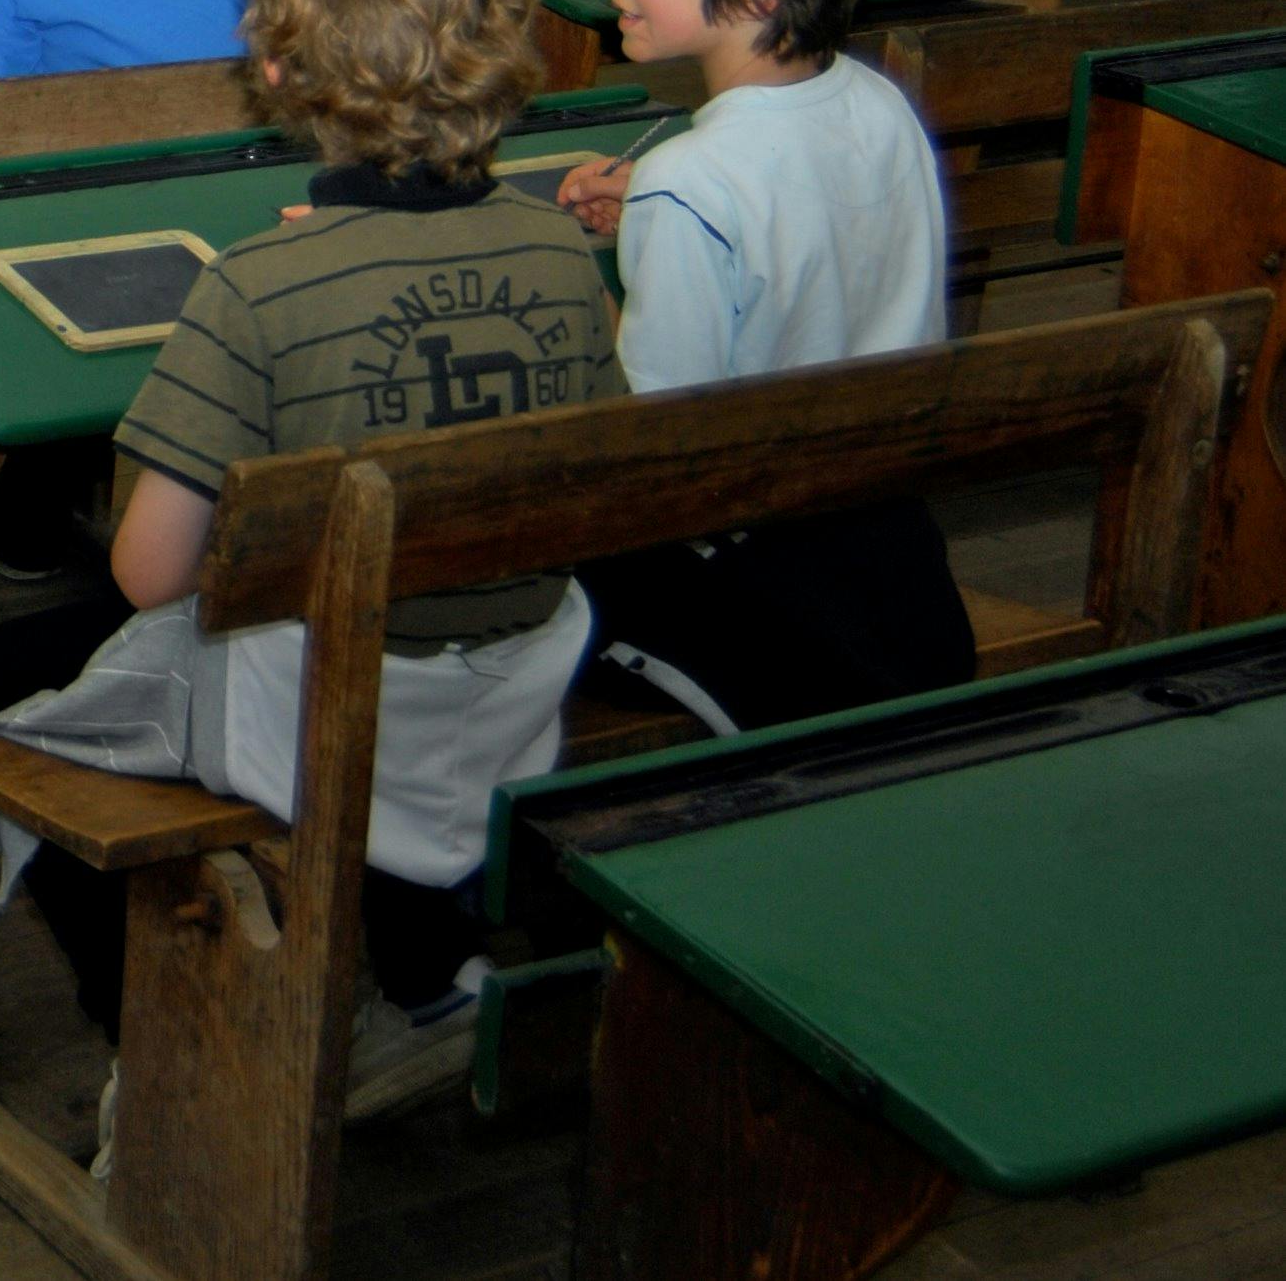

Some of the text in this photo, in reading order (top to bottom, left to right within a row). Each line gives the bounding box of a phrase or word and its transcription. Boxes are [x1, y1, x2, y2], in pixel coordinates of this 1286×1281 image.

[350, 269, 570, 380] LONSDALE
[364, 385, 408, 427] 19
[535, 365, 569, 407] 60
